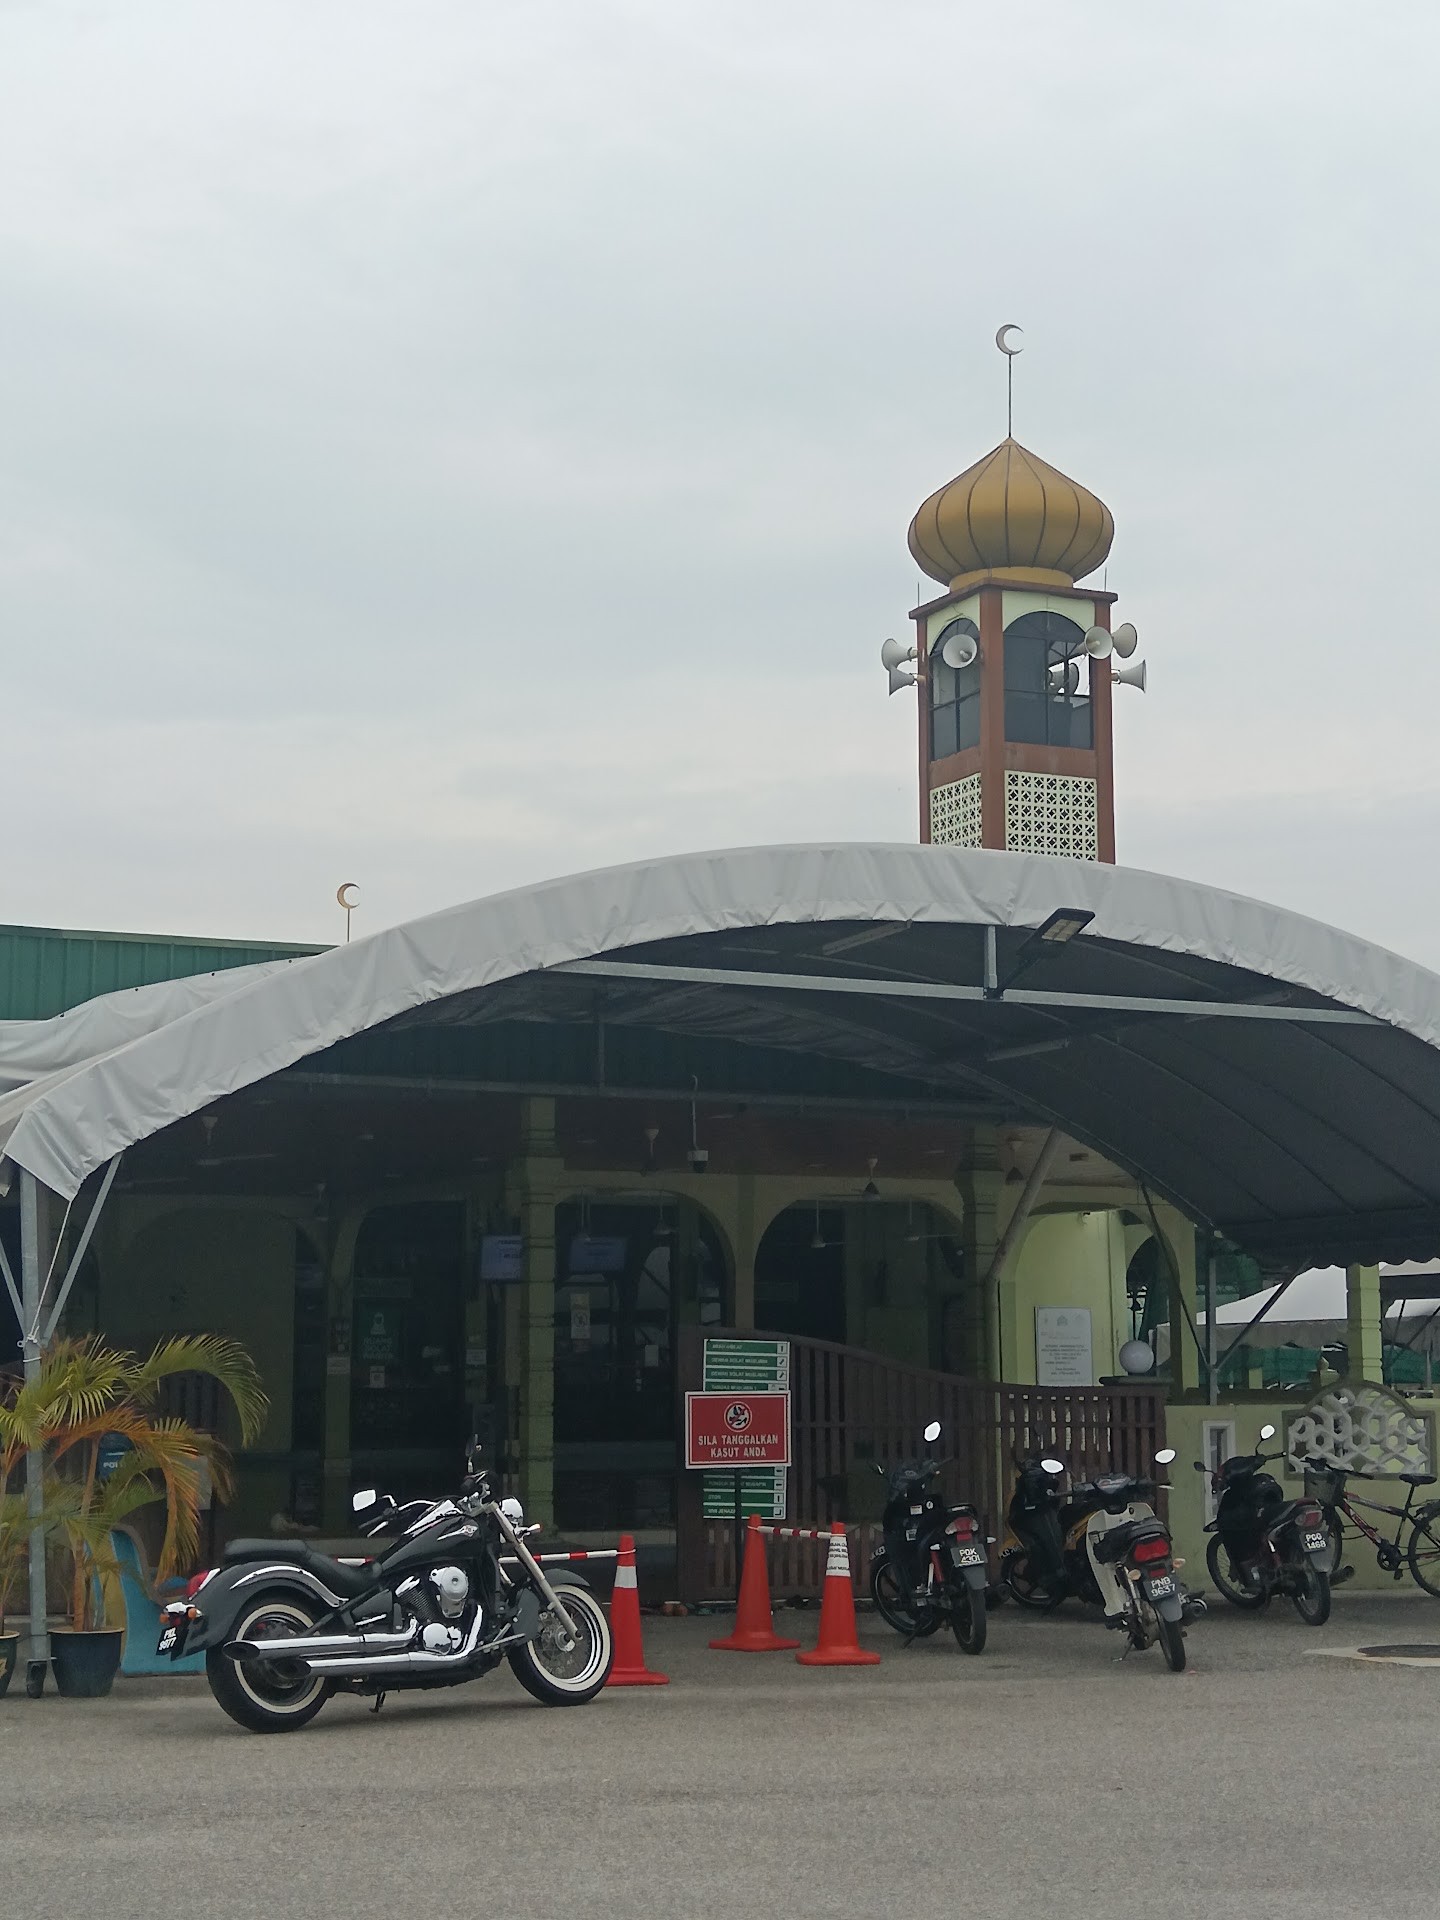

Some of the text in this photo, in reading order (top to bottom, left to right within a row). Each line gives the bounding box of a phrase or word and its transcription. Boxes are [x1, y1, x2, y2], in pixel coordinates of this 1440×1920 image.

[698, 1433, 779, 1446] SILA TANGGALKAN
[710, 1446, 767, 1458] KASUT ANDA
[1306, 1540, 1326, 1549] 1468
[1151, 1577, 1171, 1588] PNB
